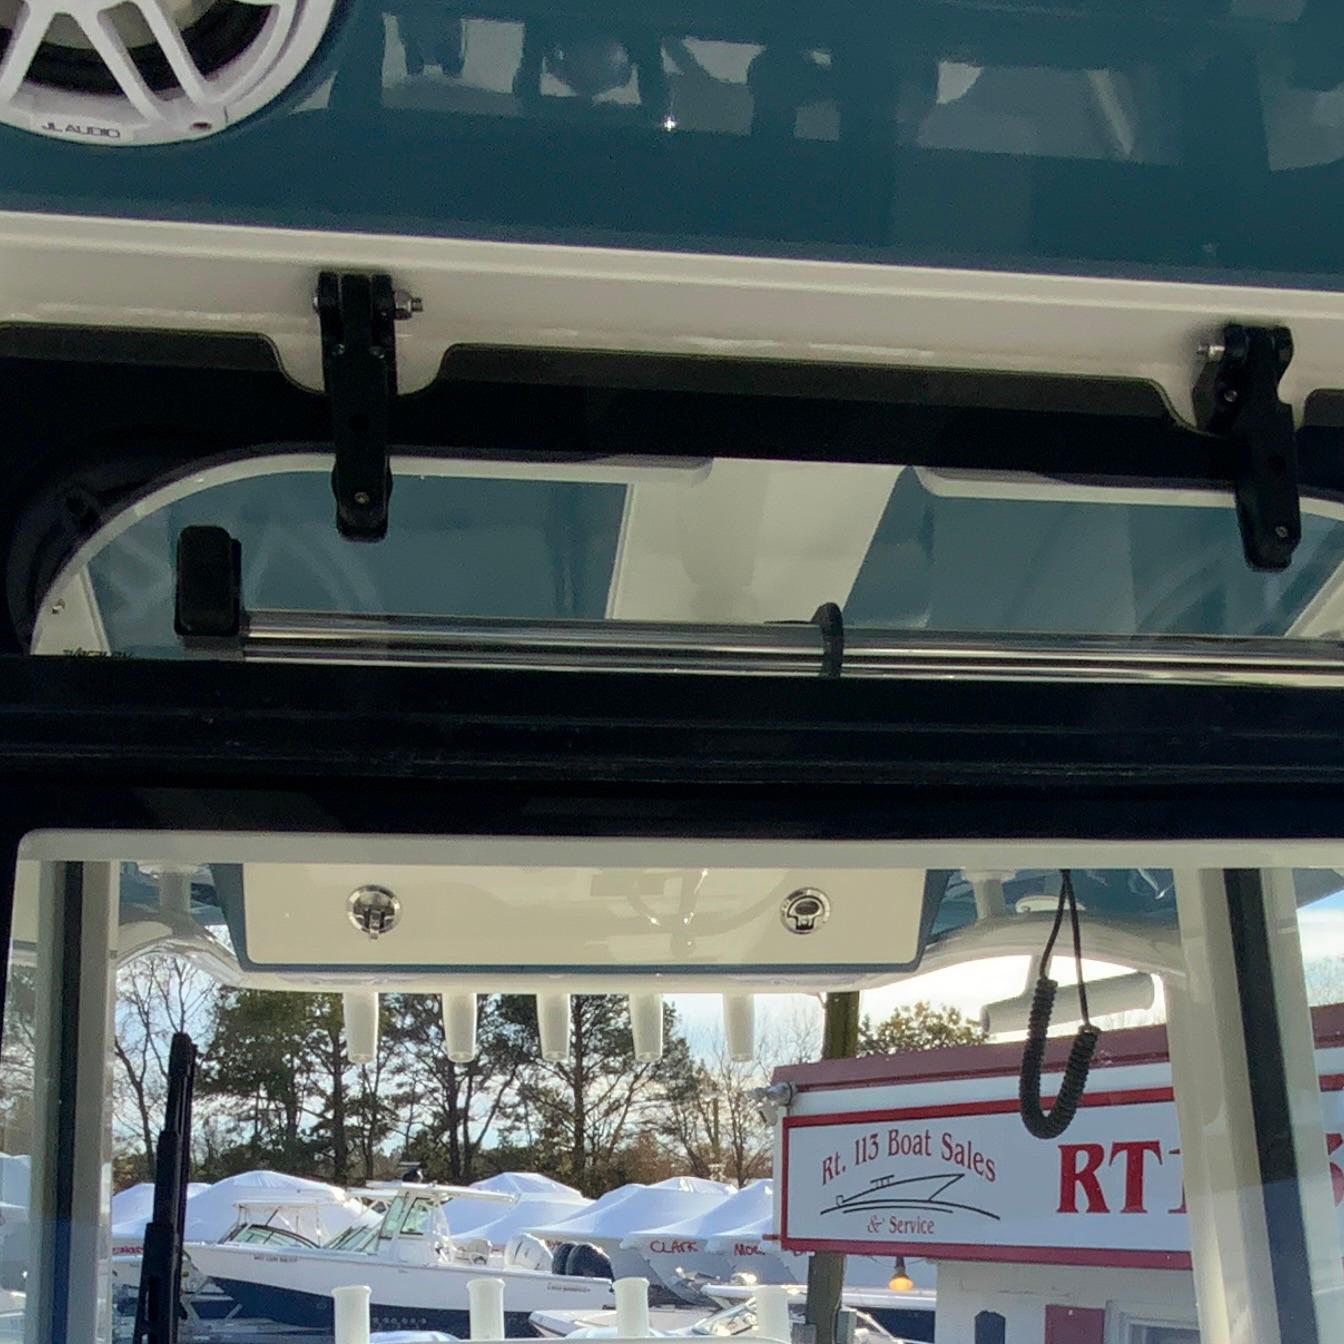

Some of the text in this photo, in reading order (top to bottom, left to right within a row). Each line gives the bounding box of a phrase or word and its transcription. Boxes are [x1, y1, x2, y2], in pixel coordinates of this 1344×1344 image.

[65, 124, 121, 138] AUDIO
[821, 1128, 996, 1186] Rt. 113 Boat Sales
[889, 1215, 935, 1235] Service
